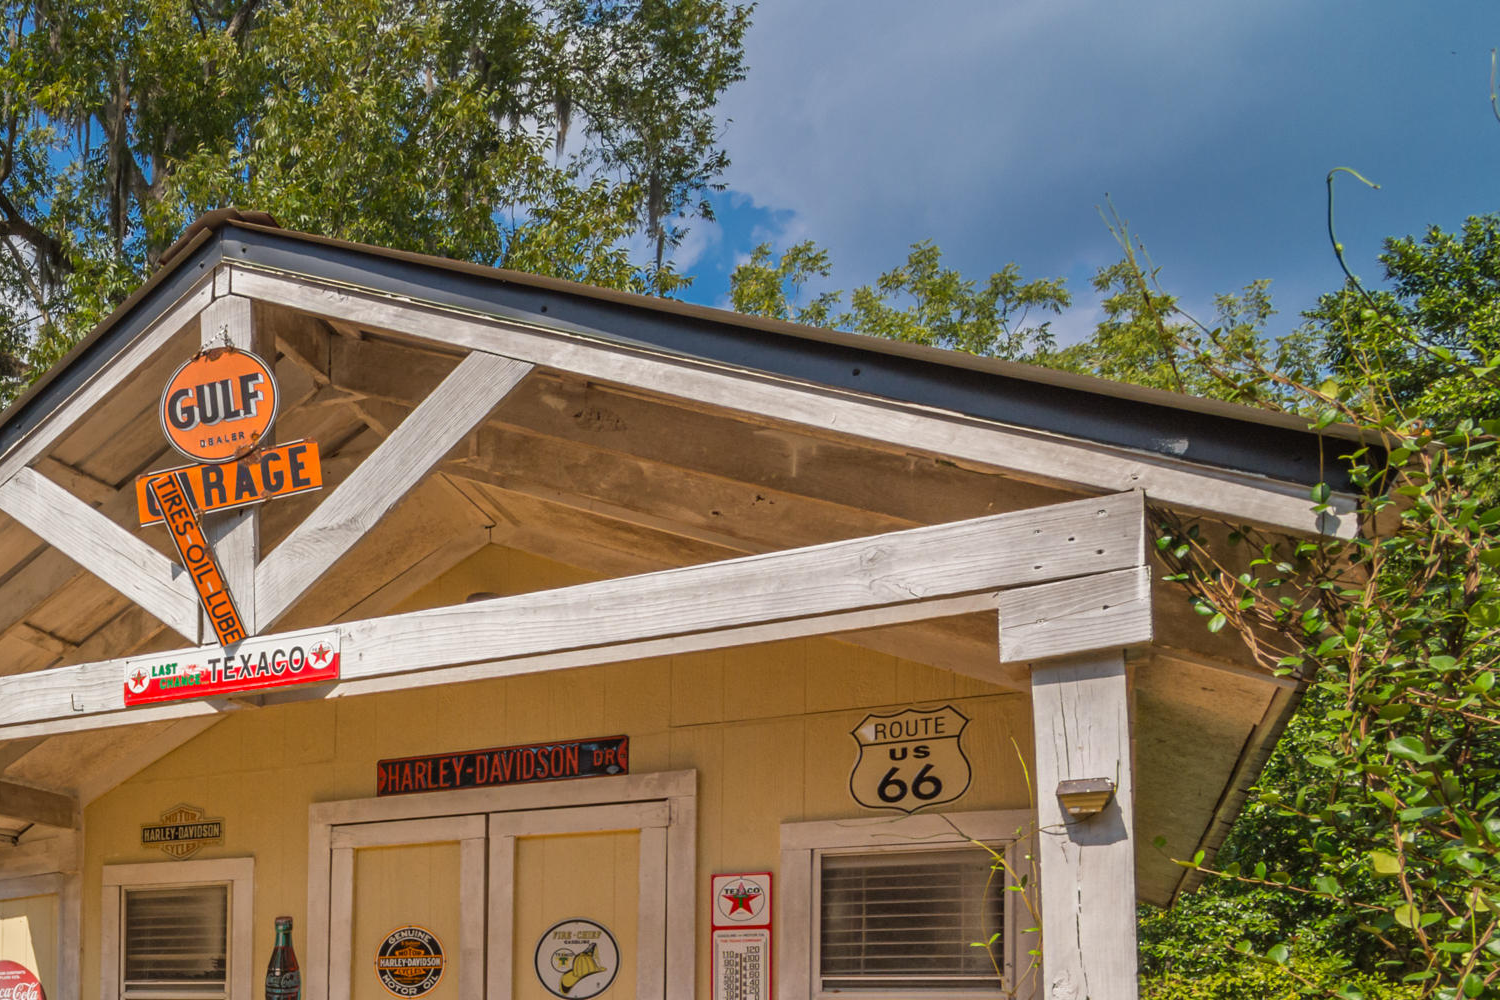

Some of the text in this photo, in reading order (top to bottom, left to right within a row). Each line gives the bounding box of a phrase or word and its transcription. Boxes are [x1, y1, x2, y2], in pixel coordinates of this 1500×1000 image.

[167, 371, 264, 432] GULF
[200, 431, 245, 448] DEALER
[151, 662, 178, 677] LAST
[207, 646, 306, 683] TEXACO
[874, 716, 946, 740] ROUTE
[889, 745, 931, 761] US
[387, 746, 615, 793] HARLEY-DAVIDSON DR
[877, 763, 943, 803] 66
[144, 823, 220, 842] HARLEY-DAVIDSON
[388, 930, 431, 944] GENUINE
[722, 950, 735, 959] 110
[746, 945, 760, 954] 120
[379, 957, 441, 967] HARLEY-DAVIDSON
[382, 975, 417, 995] MOTOR
[423, 975, 438, 989] OIL
